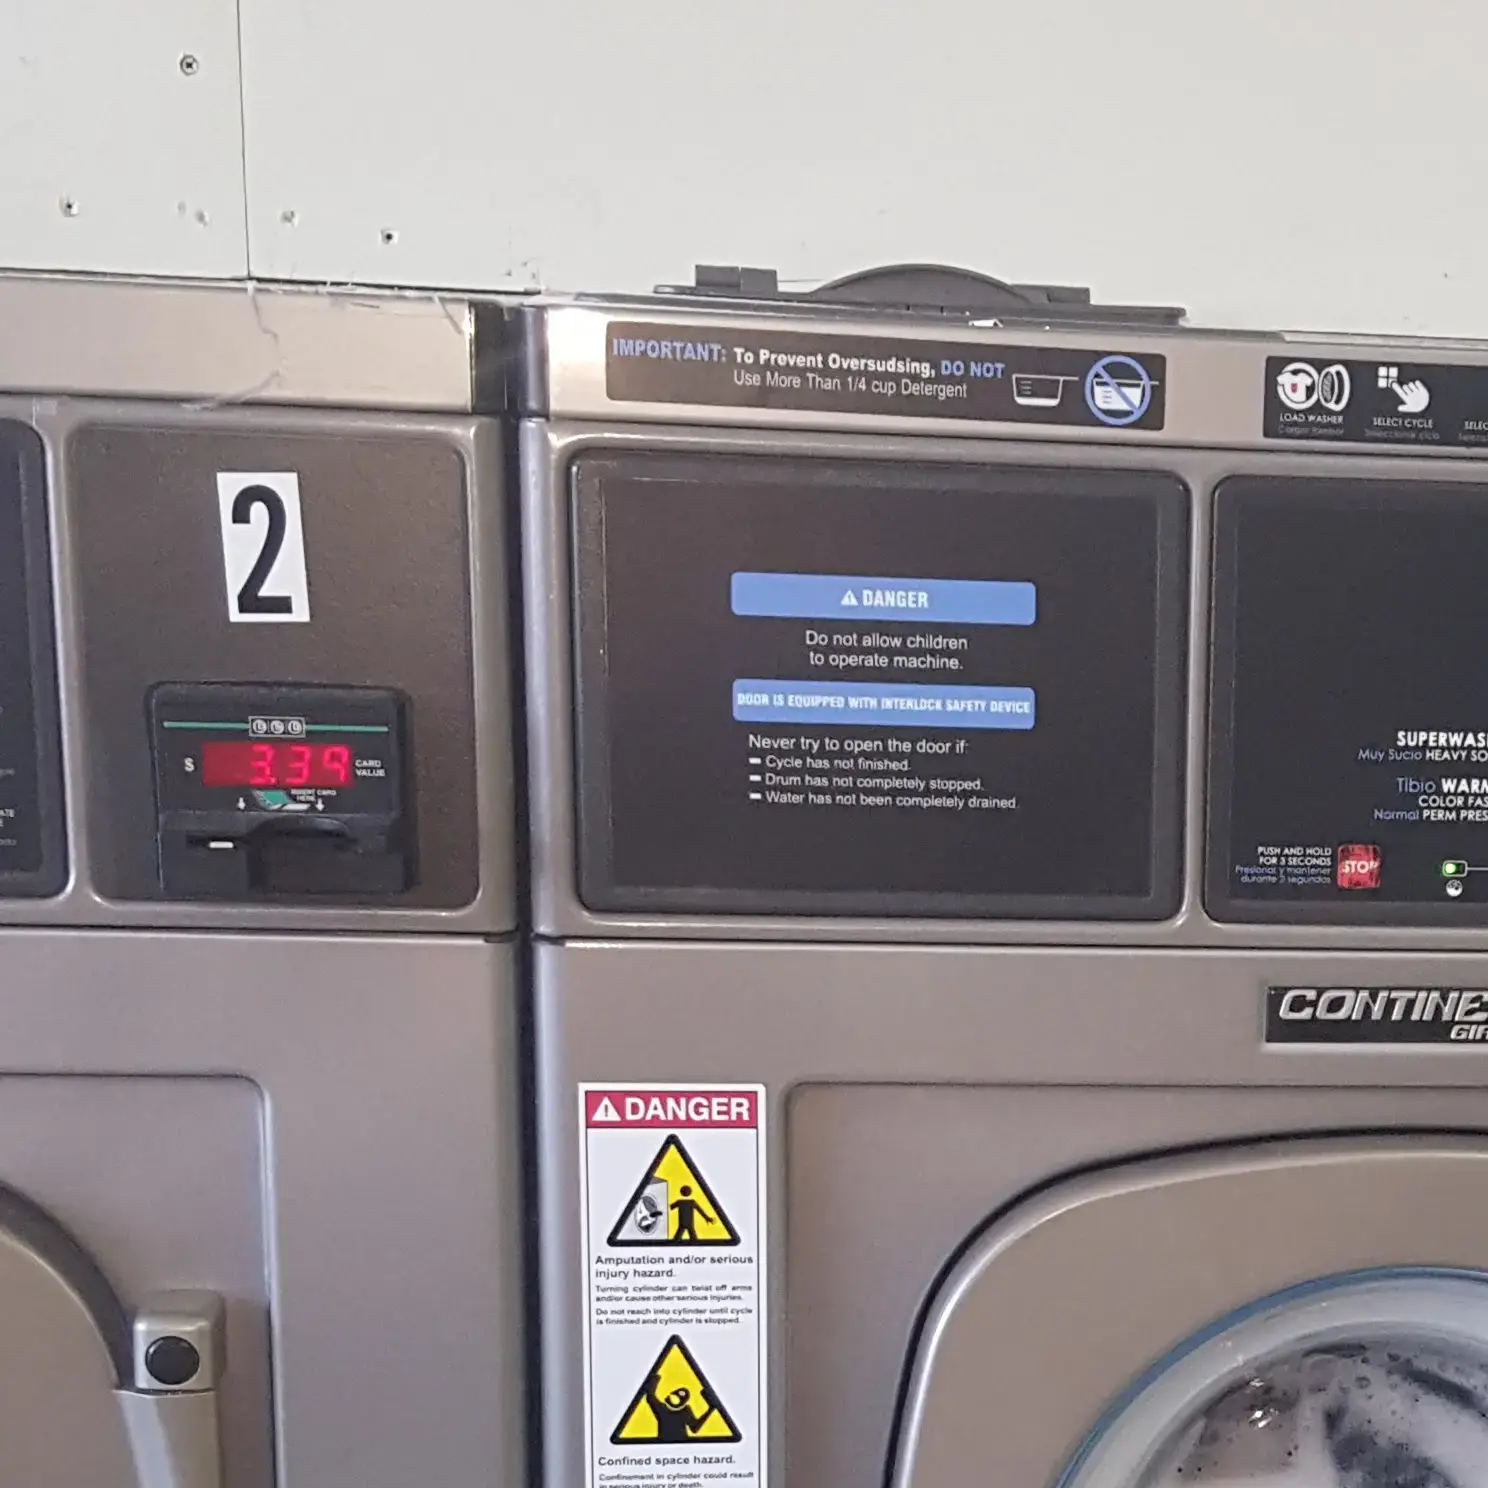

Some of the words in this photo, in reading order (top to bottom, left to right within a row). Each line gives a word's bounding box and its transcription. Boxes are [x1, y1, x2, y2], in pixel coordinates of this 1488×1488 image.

[612, 338, 726, 363] IMPORTANT:
[733, 347, 754, 364] To
[759, 349, 823, 369] Prevent
[828, 353, 936, 378] Oversudsing,
[941, 360, 964, 375] DO
[970, 362, 1005, 378] NOT
[734, 369, 761, 386] Use
[766, 372, 801, 388] More
[806, 373, 841, 390] Than
[848, 376, 867, 392] 1/4
[871, 381, 896, 396] cup
[901, 379, 967, 400] Detergent
[1280, 412, 1305, 422] LOAD
[1307, 414, 1343, 424] WASHER
[1373, 417, 1402, 426] SELECT
[1404, 418, 1433, 428] CYCLE
[231, 484, 293, 614] 2
[862, 589, 929, 608] DANGER
[805, 630, 829, 646] Do
[832, 632, 858, 647] not
[862, 632, 902, 648] allow
[906, 633, 968, 650] children
[810, 651, 825, 666] to
[829, 652, 889, 669] operate
[893, 654, 964, 670] machine.
[737, 693, 769, 706] DOOR
[773, 694, 784, 707] IS
[788, 694, 845, 708] EQUIPPED
[847, 696, 877, 710] WITH
[881, 697, 943, 711] INTERLOCK
[945, 699, 987, 713] SAFETY
[989, 701, 1030, 714] DEVICE
[748, 733, 796, 750] Never
[800, 736, 820, 753] try
[824, 737, 839, 751] to
[844, 740, 883, 754] open
[888, 738, 912, 752] the
[916, 738, 951, 754] door
[1358, 749, 1385, 761] Muy
[1388, 749, 1423, 761] Sucio
[1425, 749, 1467, 761] HEAVY
[355, 760, 381, 768] CARD
[765, 755, 802, 770] Cycle
[806, 756, 830, 769] has
[833, 757, 854, 770] not
[858, 757, 911, 771] finished.
[355, 768, 385, 777] VALUE
[765, 773, 801, 785] Drum
[804, 774, 829, 787] has
[832, 775, 853, 787] not
[856, 776, 926, 791] completely
[929, 777, 985, 792] stopped.
[1397, 777, 1436, 793] Tibio
[765, 791, 805, 803] Water
[808, 792, 832, 804] has
[835, 793, 857, 805] not
[859, 793, 892, 806] been
[896, 795, 965, 810] completely
[1418, 795, 1464, 807] COLOR
[1373, 809, 1419, 820] Normal
[1422, 809, 1456, 821] PERM
[1257, 846, 1280, 855] PUSH
[1282, 846, 1304, 855] AND
[1305, 847, 1332, 855] HOLD
[1259, 856, 1277, 865] FOR
[1287, 856, 1332, 866] SECONDS
[625, 1096, 750, 1122] DANGER
[595, 1255, 665, 1266] Amputation
[668, 1254, 707, 1264] and/or
[710, 1255, 753, 1264] serious
[595, 1268, 630, 1280] injury
[633, 1268, 676, 1278] hazard.
[595, 1285, 628, 1294] Turning
[672, 1307, 707, 1315] cylinder
[730, 1307, 753, 1315] cycle
[659, 1317, 693, 1326] cylinder
[598, 1456, 651, 1466] Confined
[655, 1457, 690, 1467] space
[693, 1455, 736, 1465] hazard.
[599, 1473, 654, 1481] Confinement
[666, 1472, 700, 1481] cylinder
[703, 1471, 728, 1479] could
